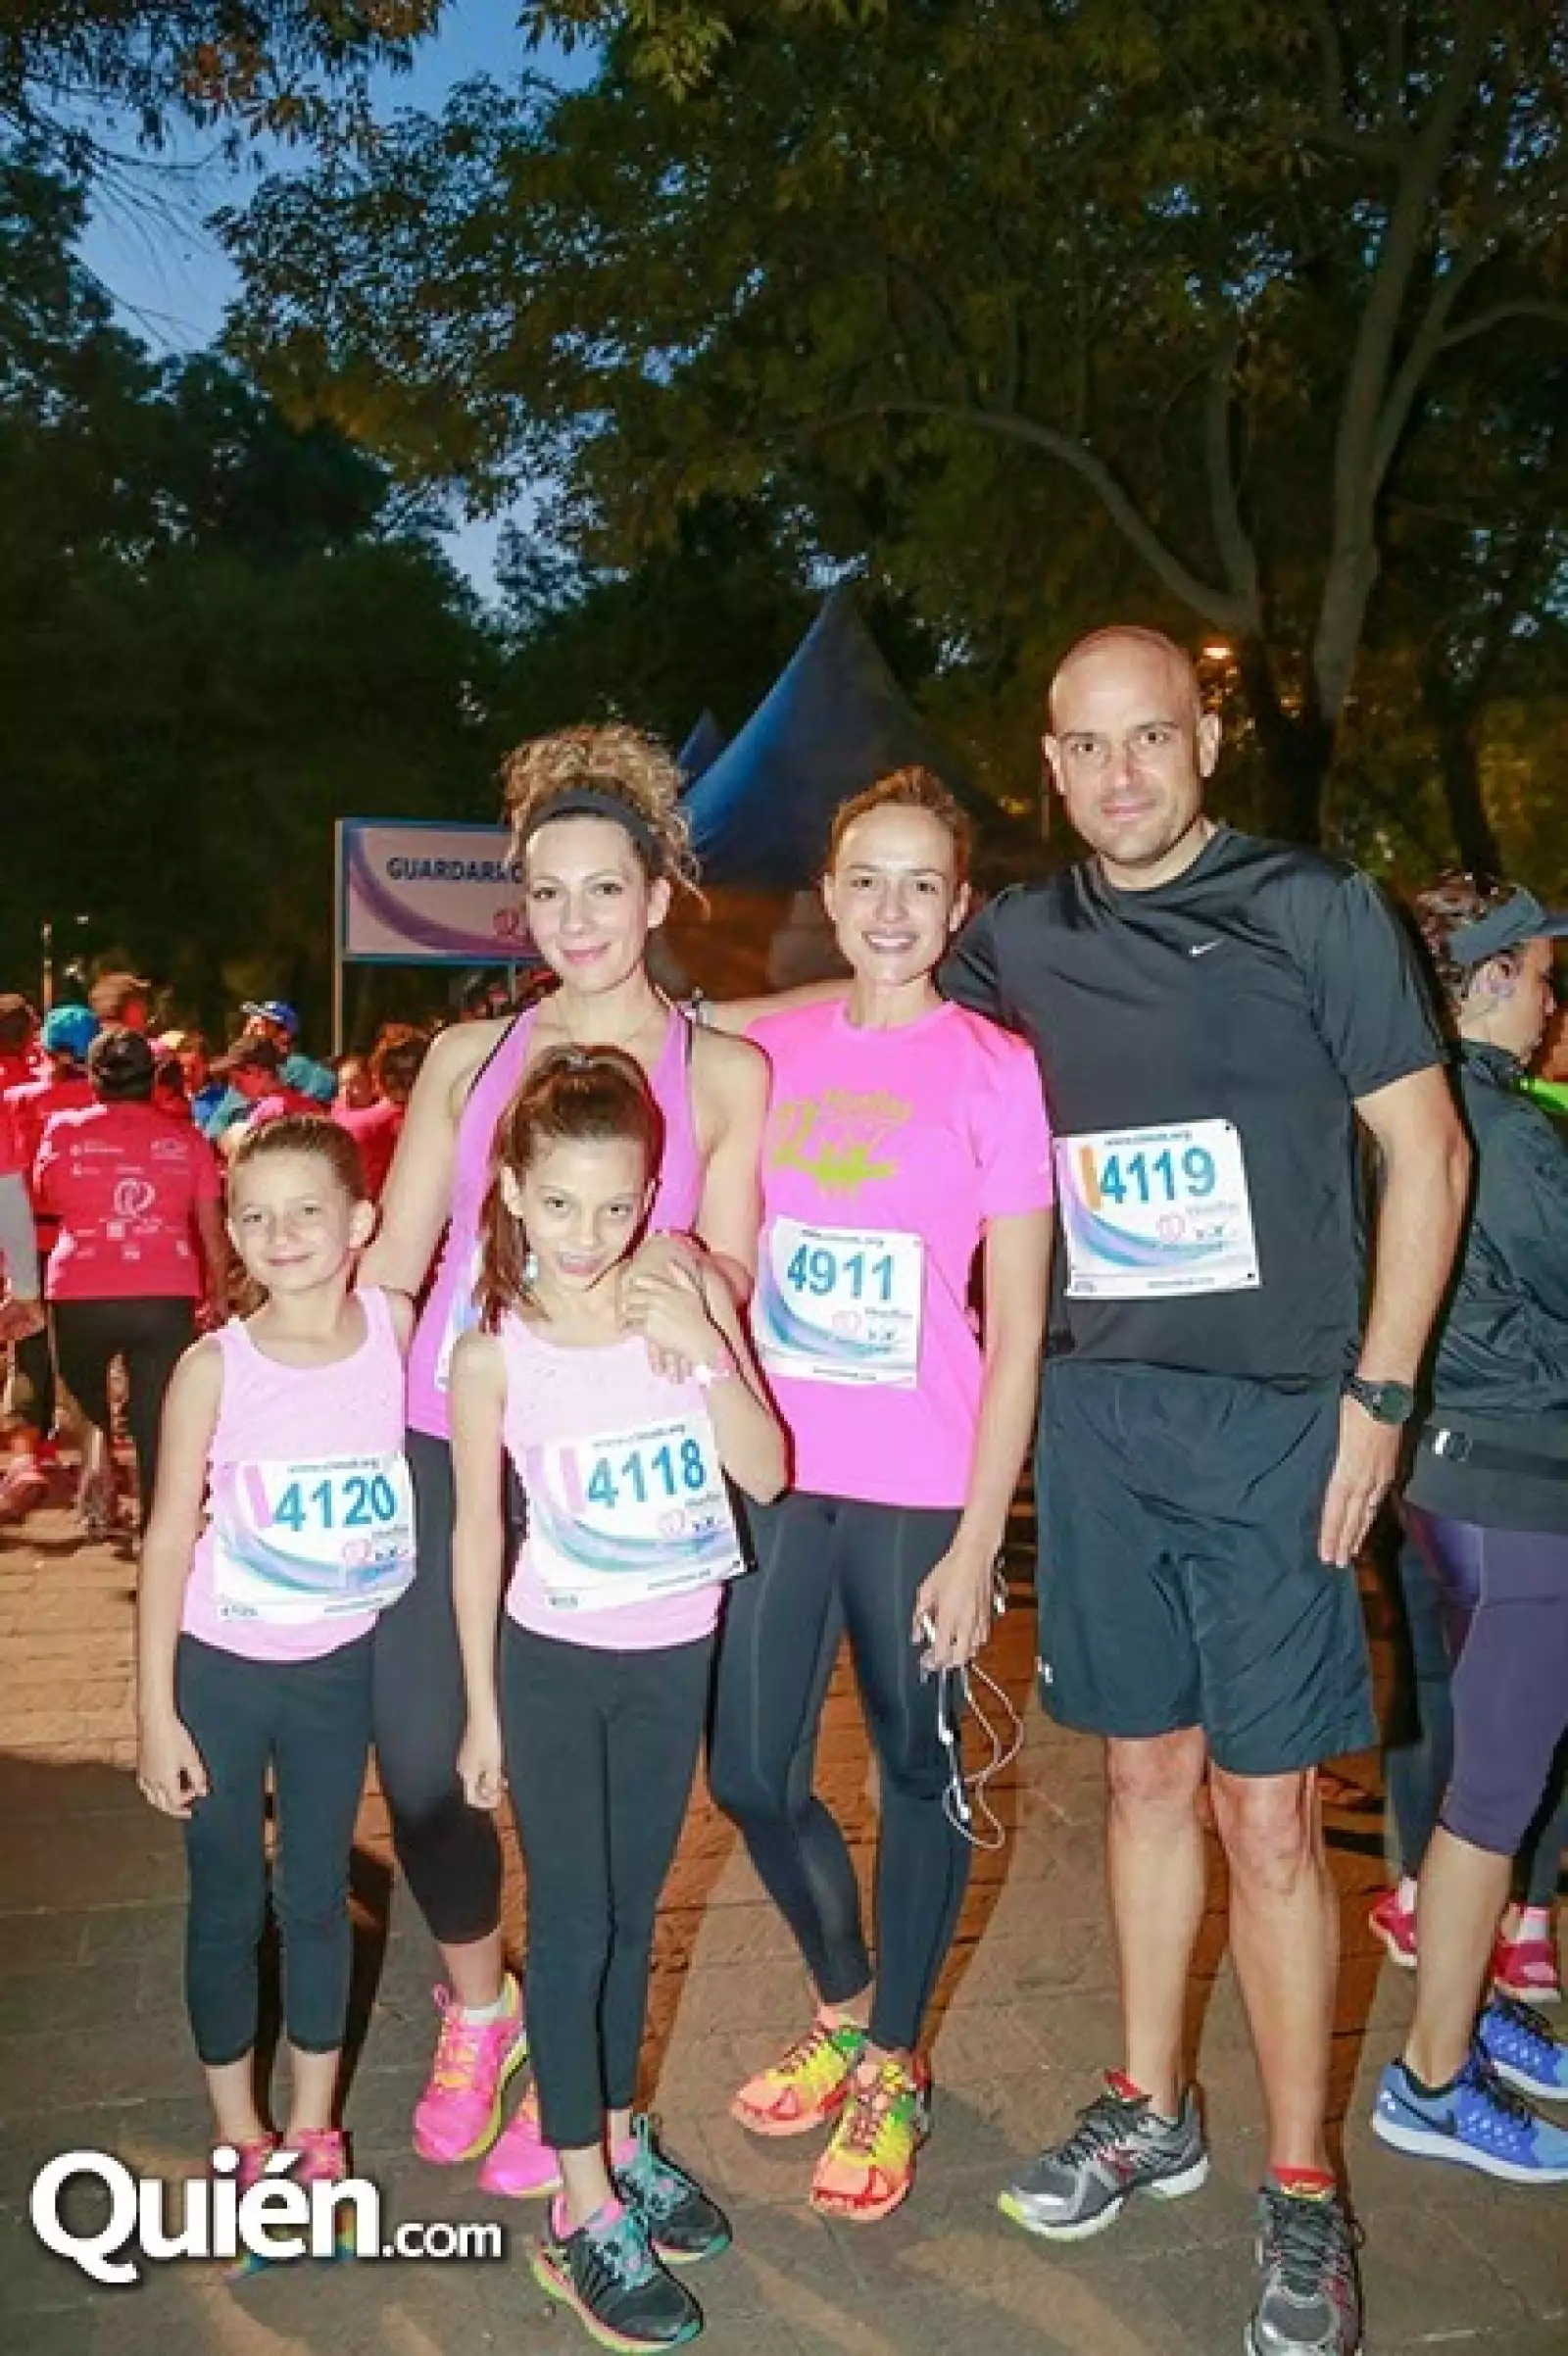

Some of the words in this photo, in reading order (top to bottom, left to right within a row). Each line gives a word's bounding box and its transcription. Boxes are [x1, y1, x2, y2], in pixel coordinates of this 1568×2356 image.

[1101, 1148, 1215, 1204] 4119
[787, 1244, 895, 1301] 4911
[272, 1473, 398, 1532] 4120
[587, 1439, 707, 1508] 4118
